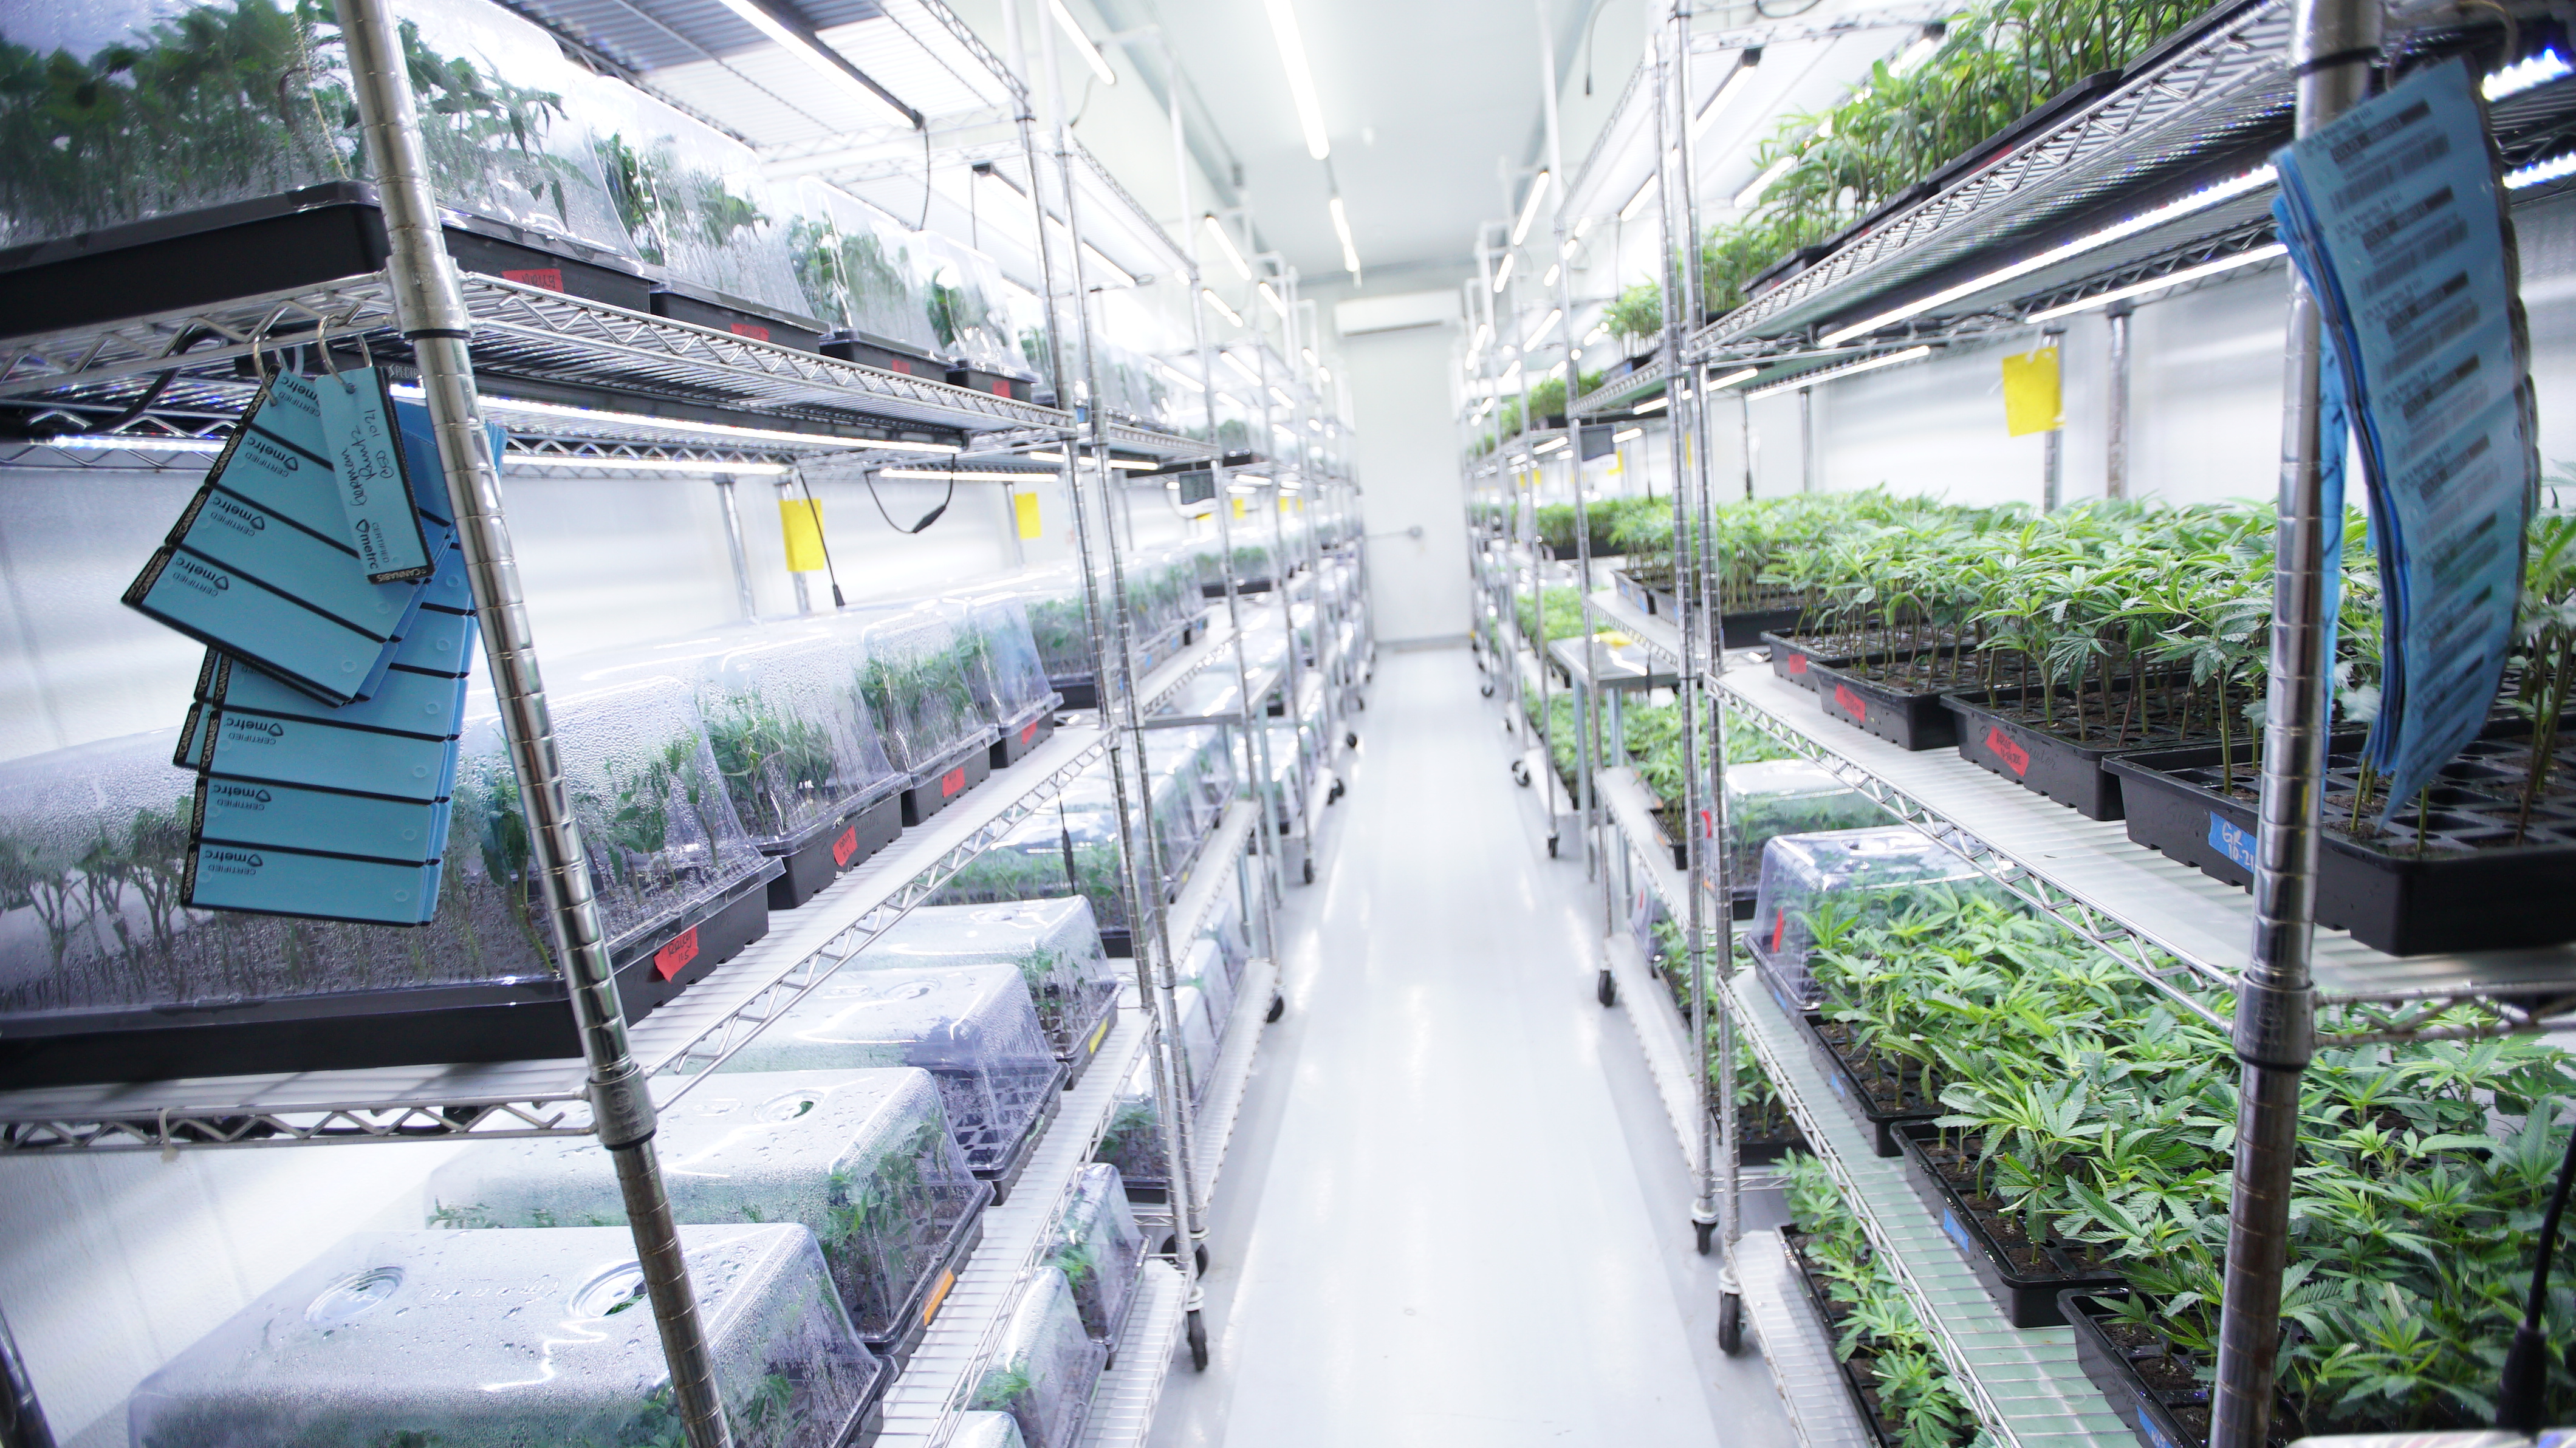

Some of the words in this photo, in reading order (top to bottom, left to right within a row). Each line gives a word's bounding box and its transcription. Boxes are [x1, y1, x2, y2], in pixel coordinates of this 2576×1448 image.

[388, 364, 420, 380] SPECTR
[248, 371, 276, 414] CANNBIS
[282, 376, 318, 399] metrc
[279, 391, 321, 417] CERTIFIED
[247, 437, 286, 460] metrc
[245, 451, 289, 477] CERTIFIED
[214, 496, 252, 520] metrc
[211, 511, 255, 537] CERTIFIED
[360, 534, 379, 569] metrc
[372, 522, 389, 562] CERTIFIED
[176, 557, 216, 581] metrc
[376, 567, 420, 581] CANNABIS
[173, 572, 219, 598] CERTIFIED
[227, 717, 268, 731] metrc
[228, 733, 276, 745] CERTIFIED
[214, 785, 255, 797] metrc
[217, 799, 265, 811] CERTIFIED
[205, 850, 247, 862] metrc
[208, 864, 256, 875] CERTIFIED
